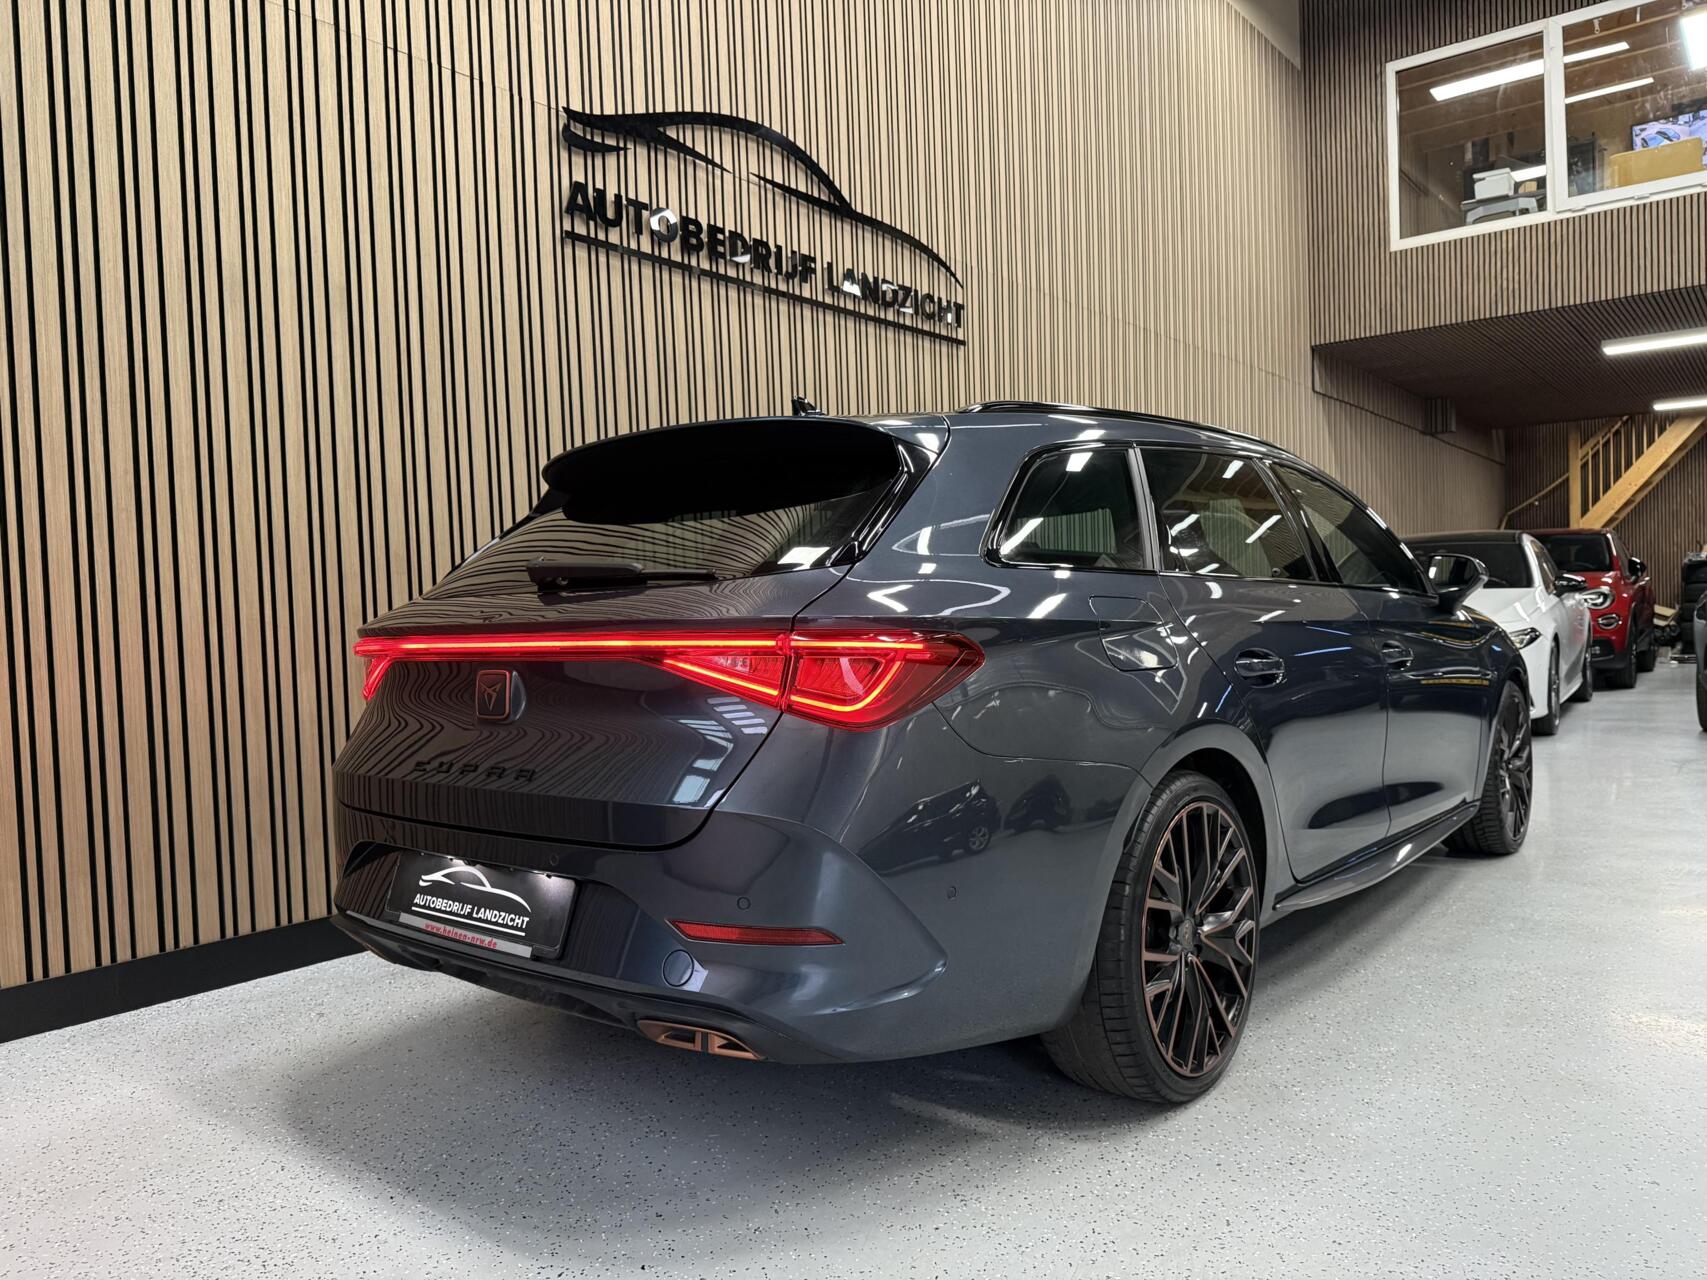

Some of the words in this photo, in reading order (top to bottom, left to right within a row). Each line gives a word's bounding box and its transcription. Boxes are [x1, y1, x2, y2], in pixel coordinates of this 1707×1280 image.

[565, 180, 817, 284] AUTOBEDRIJF
[825, 261, 966, 329] LANDZICHT
[413, 893, 473, 916] AUTOBEDRIJF
[472, 905, 530, 929] LANDZICHT
[424, 921, 498, 949] www.heinen-nrw.de
